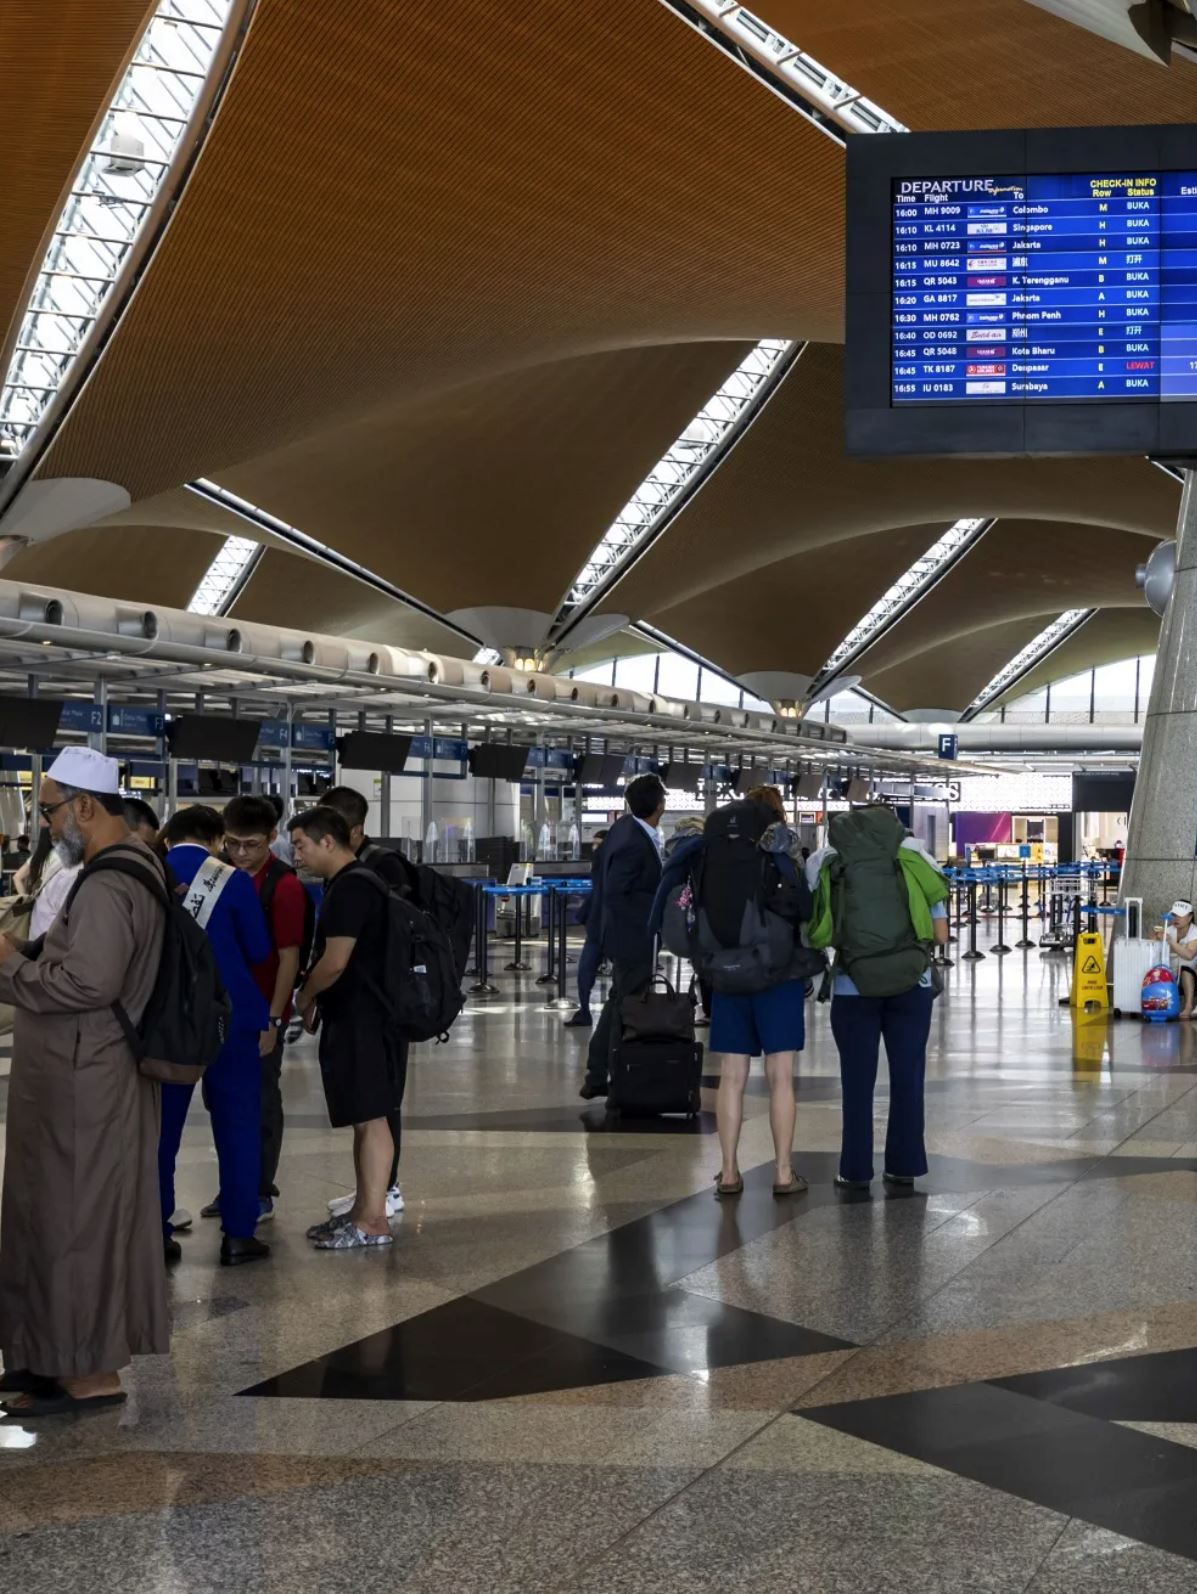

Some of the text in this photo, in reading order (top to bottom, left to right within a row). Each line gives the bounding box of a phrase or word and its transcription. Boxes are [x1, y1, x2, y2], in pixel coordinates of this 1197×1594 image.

[902, 180, 994, 193] DEPARTURE
[1090, 178, 1156, 187] CHECK-IN INFO
[924, 194, 948, 203] Flight
[1014, 191, 1023, 199] To
[1093, 189, 1111, 197] Row
[1128, 188, 1154, 196] Status
[896, 209, 917, 217] 16:00
[1013, 205, 1048, 214] Colombo
[896, 226, 917, 234] 16:10
[1013, 224, 1053, 232] Singapore
[1127, 219, 1149, 227] BUKA
[896, 244, 917, 252] 16:10
[925, 242, 938, 250] MH
[1127, 237, 1149, 245] BUKA
[1126, 255, 1142, 264] 打开
[896, 279, 916, 287] 16:15
[1022, 276, 1069, 285] Terengganu
[1127, 272, 1149, 280] BUKA
[938, 294, 957, 302] 8817
[1012, 294, 1040, 302] Jakarta
[1127, 290, 1149, 298] BUKA
[1042, 311, 1061, 319] Penh
[1127, 308, 1149, 316] BUKA
[1126, 326, 1141, 335] 打开
[1033, 346, 1055, 354] Bharu
[1126, 344, 1149, 352] BUKA
[895, 367, 915, 375] 16:45
[1127, 362, 1154, 370] LEWAT
[1012, 382, 1048, 392] Surabaya
[1126, 379, 1148, 387] BUKA
[91, 711, 101, 725] F2
[942, 738, 951, 752] F
